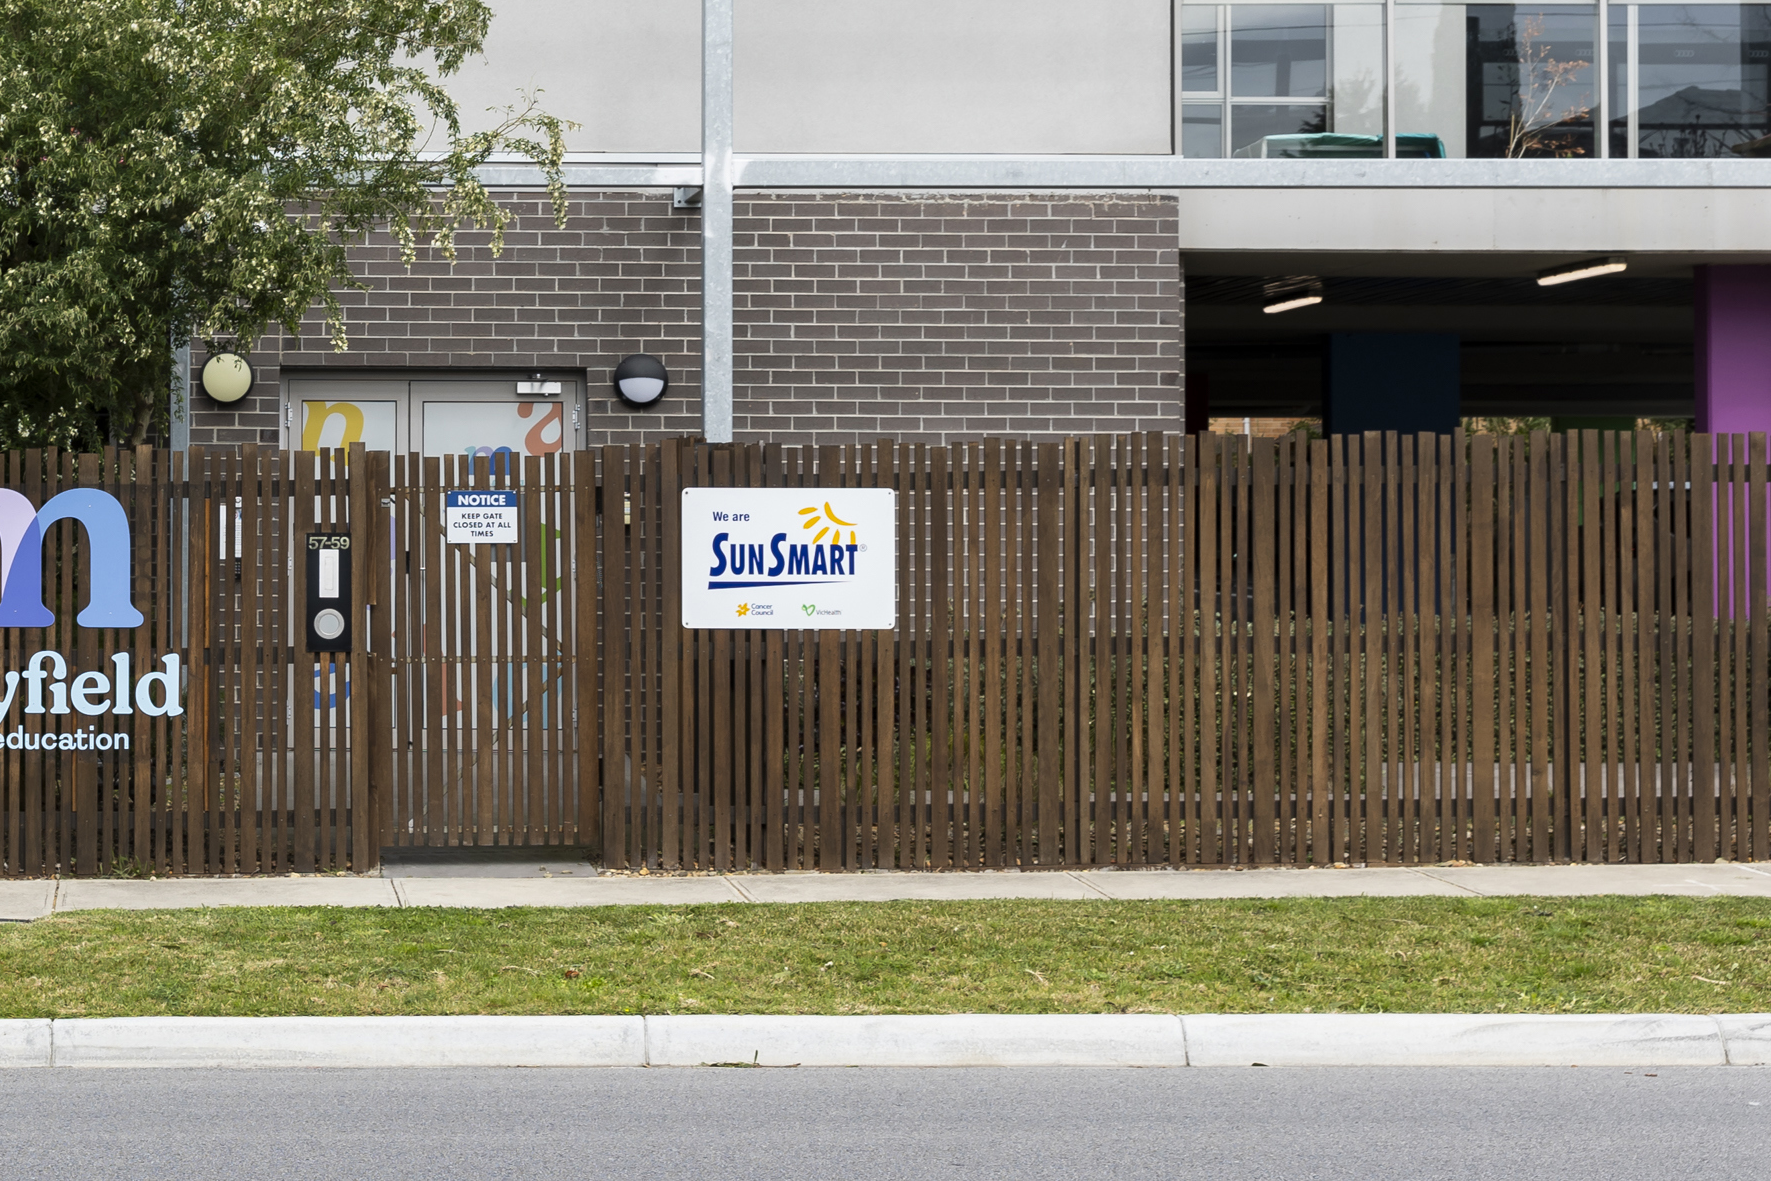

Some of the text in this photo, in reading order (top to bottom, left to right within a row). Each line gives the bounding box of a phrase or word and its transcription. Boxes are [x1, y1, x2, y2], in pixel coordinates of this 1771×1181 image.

[457, 494, 506, 506] NOTICE
[461, 512, 503, 520] KEEP GATE
[712, 511, 750, 522] We are
[453, 521, 512, 529] CLOSED AT ALL
[308, 536, 350, 550] 57-59
